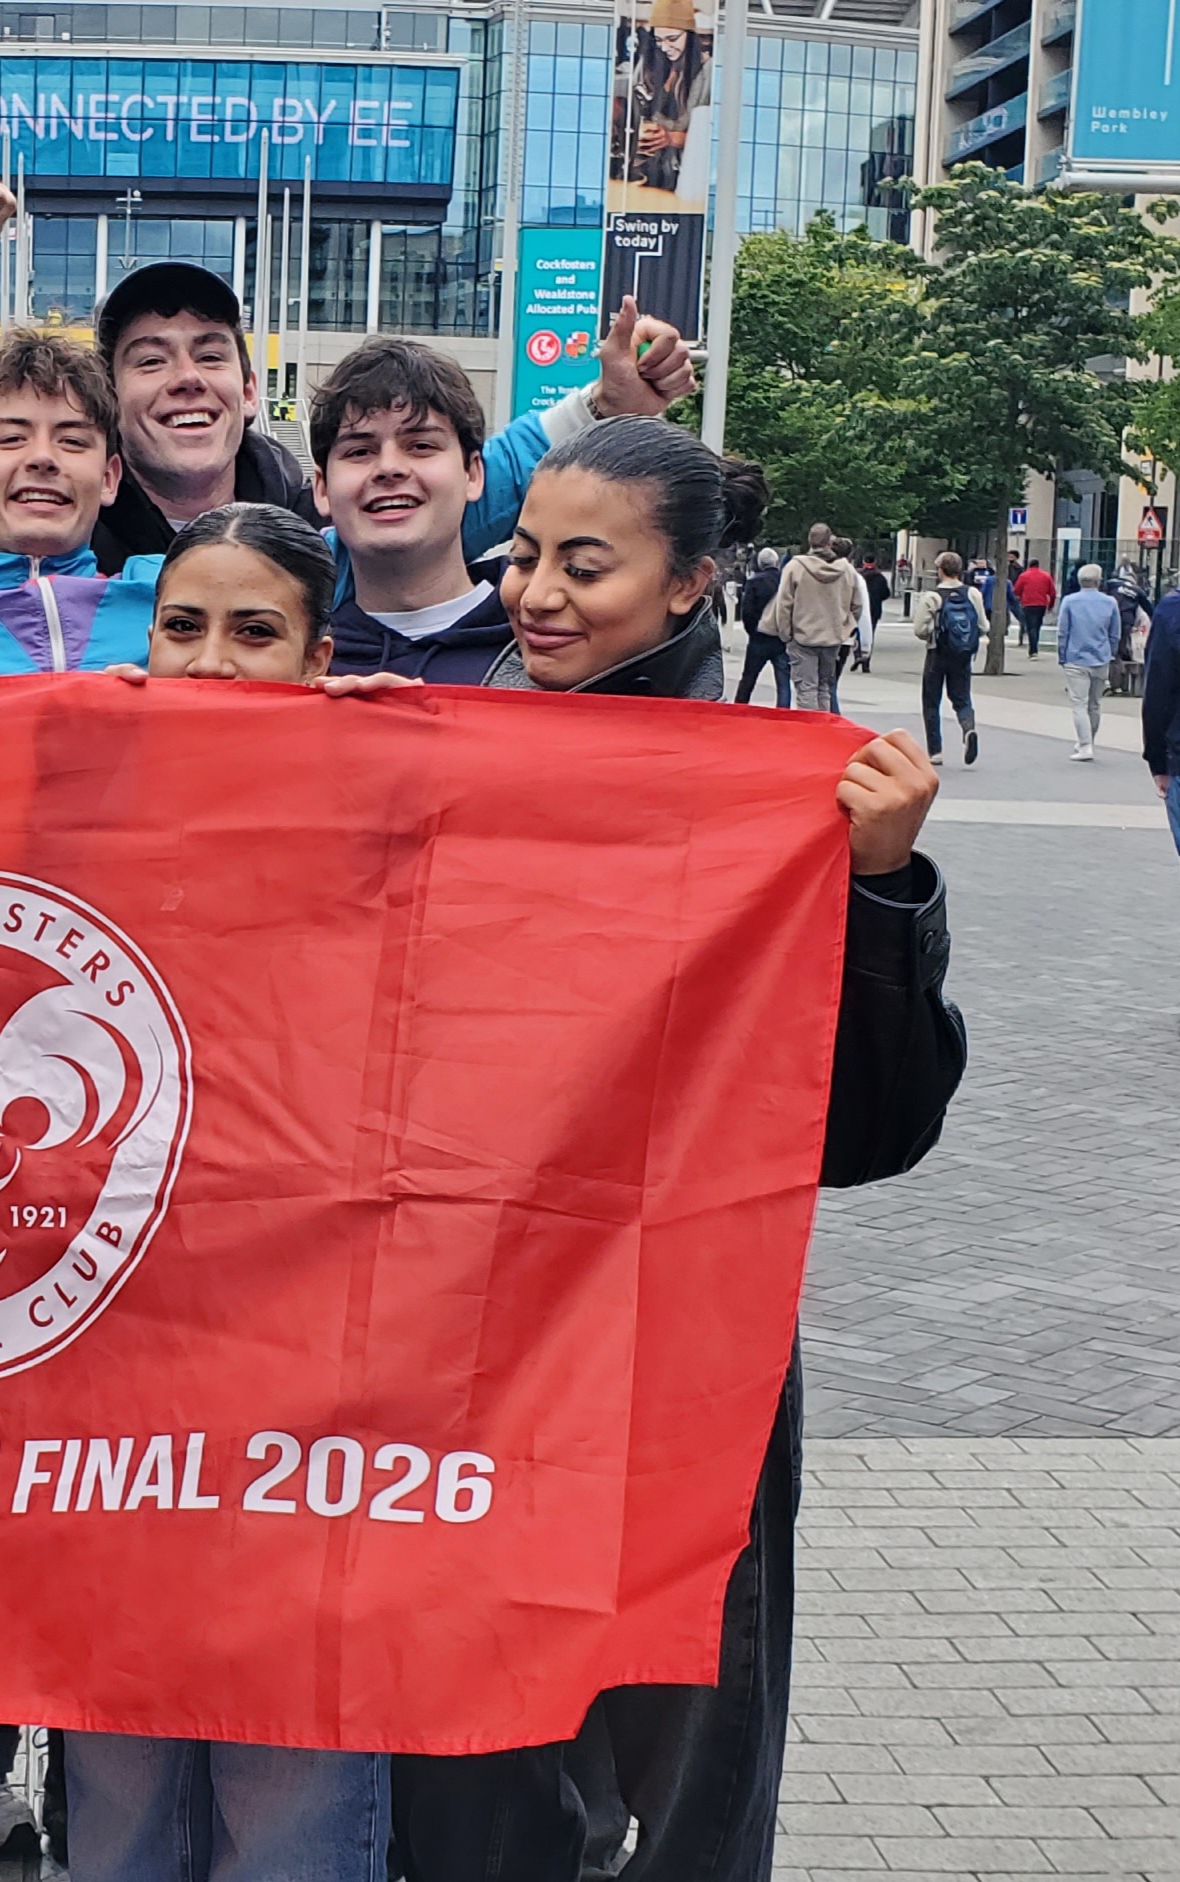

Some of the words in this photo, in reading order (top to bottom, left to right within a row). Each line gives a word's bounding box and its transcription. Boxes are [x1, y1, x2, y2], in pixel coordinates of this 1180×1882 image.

[1091, 106, 1169, 122] Wembley
[271, 97, 337, 145] BY
[348, 100, 413, 148] EE
[1091, 121, 1128, 133] Park
[615, 218, 658, 235] Swing
[661, 218, 680, 235] by
[614, 235, 657, 250] today
[536, 259, 596, 270] Cockfosters
[555, 274, 576, 284] and
[533, 289, 596, 300] Wealdstone
[526, 304, 575, 314] Allocated
[577, 304, 598, 314] Pub
[10, 1205, 67, 1229] 1921
[28, 1220, 124, 1328] CLUB
[11, 1432, 219, 1513] FINAL
[242, 1430, 496, 1523] 2026
